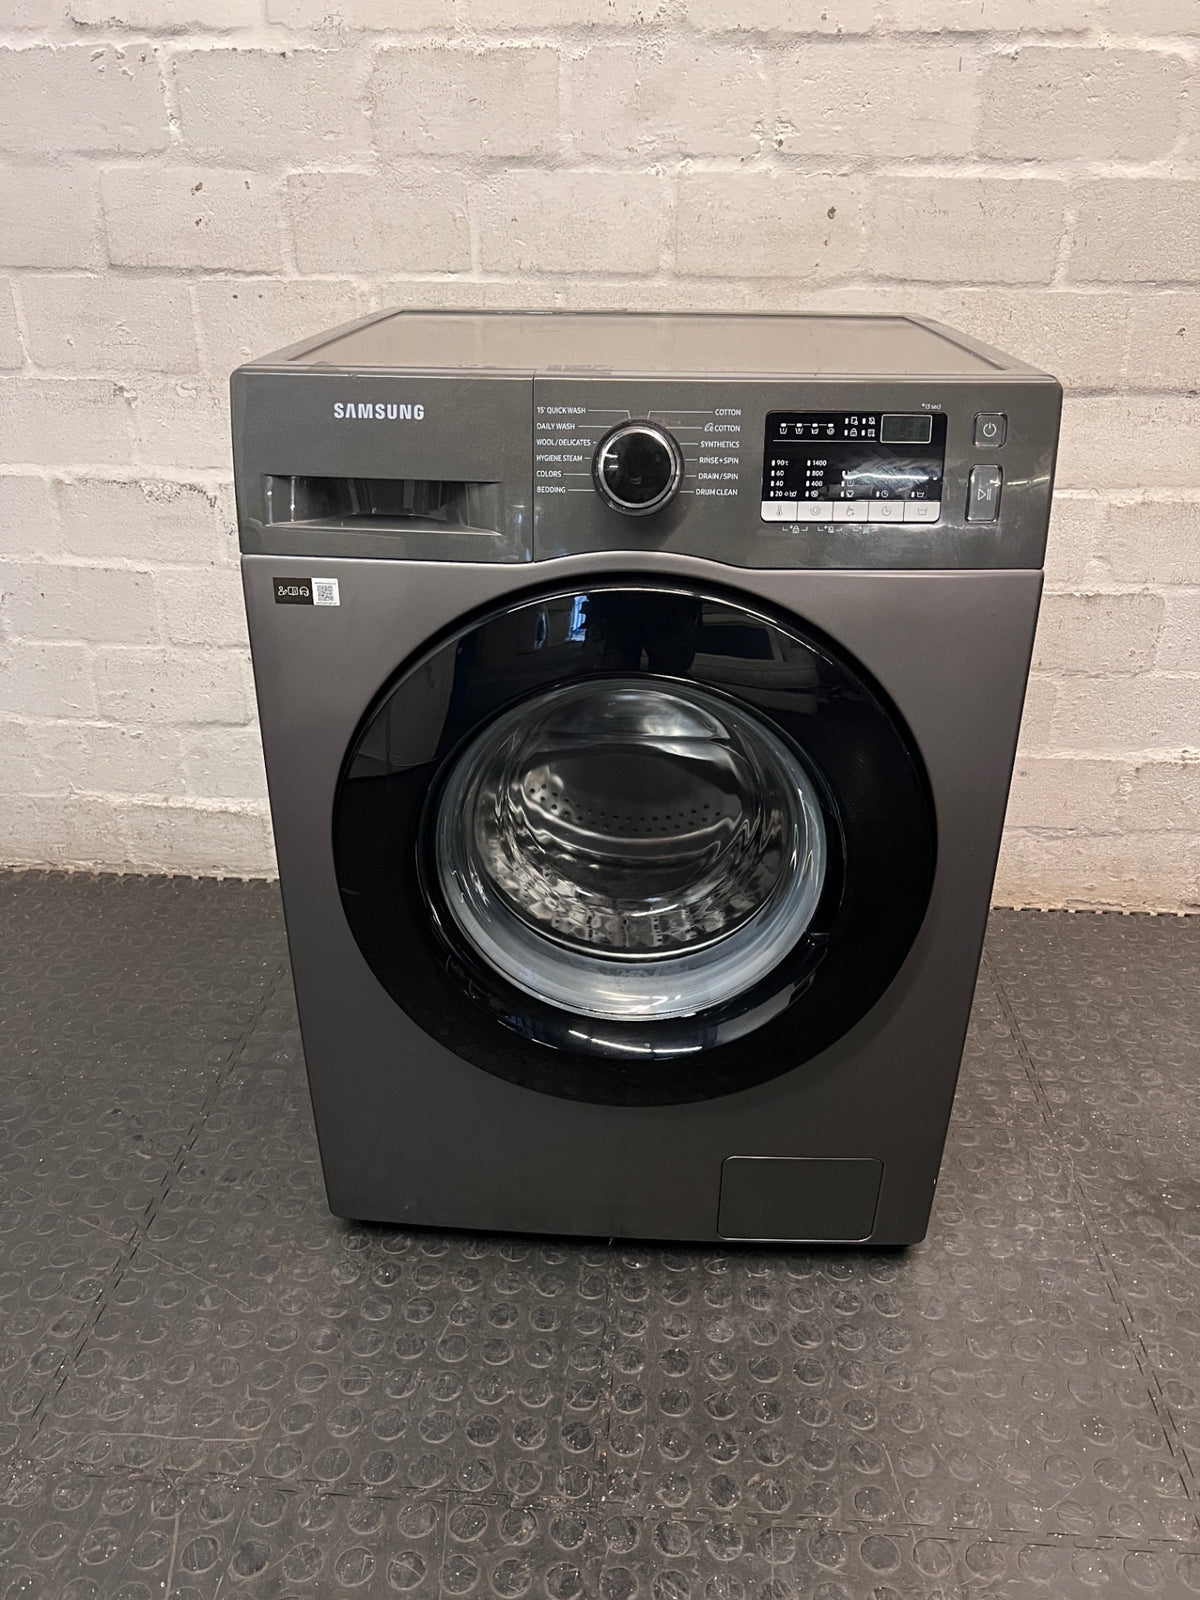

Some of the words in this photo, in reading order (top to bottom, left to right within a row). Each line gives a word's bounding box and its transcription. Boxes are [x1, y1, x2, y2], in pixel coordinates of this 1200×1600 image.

[333, 402, 425, 421] SAMSUNG
[546, 406, 567, 414] QUICK
[714, 408, 742, 416] COTTON
[700, 440, 740, 448] SYNTHETICS
[536, 470, 562, 478] COLORS
[536, 486, 566, 494] BEDDING
[696, 488, 716, 496] DRUM
[716, 488, 738, 496] CLEAN
